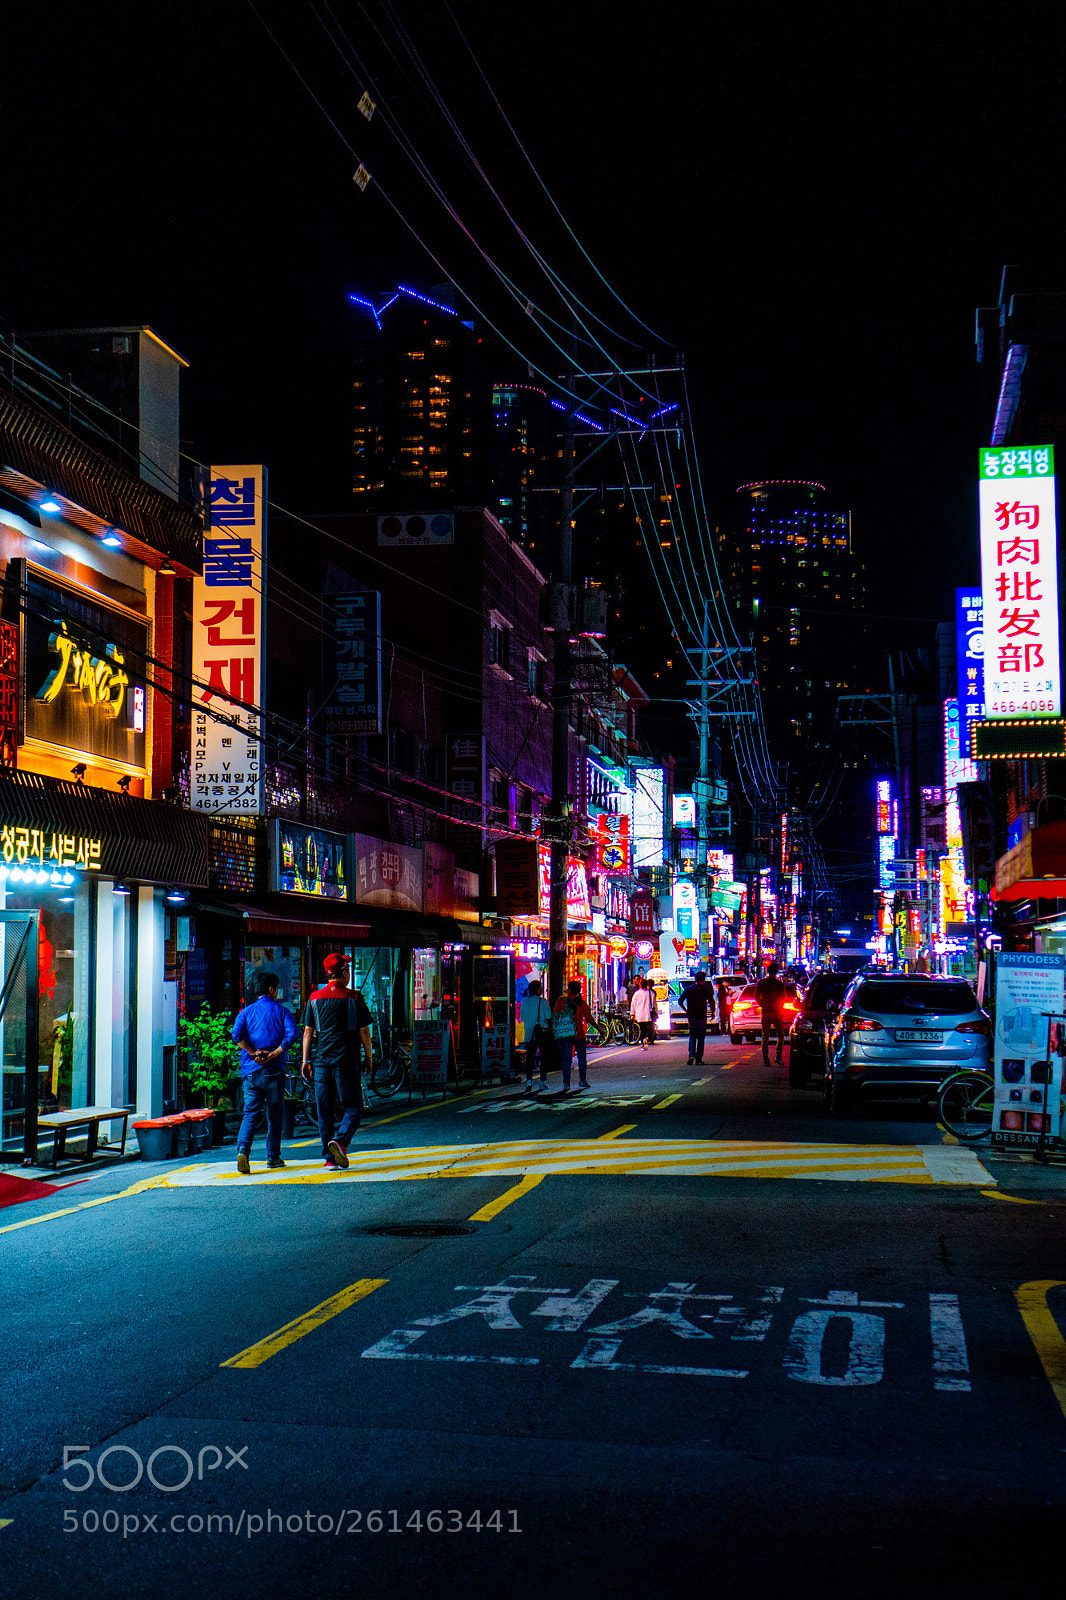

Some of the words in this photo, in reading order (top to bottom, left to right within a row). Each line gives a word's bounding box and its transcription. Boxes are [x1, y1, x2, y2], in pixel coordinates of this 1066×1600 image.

[983, 448, 1050, 477] 농장직영
[994, 500, 1044, 673] 狗肉批发部
[961, 596, 983, 608] 올바
[992, 700, 1054, 712] 466-4096
[196, 785, 256, 796] 각종공사
[196, 799, 258, 809] 464-1382
[1, 825, 46, 864] 성공자
[50, 833, 102, 870] 샤브샤브
[1002, 954, 1061, 966] PHYTODESS
[995, 1133, 1055, 1145] DESSANE
[361, 1275, 973, 1392] 천천히
